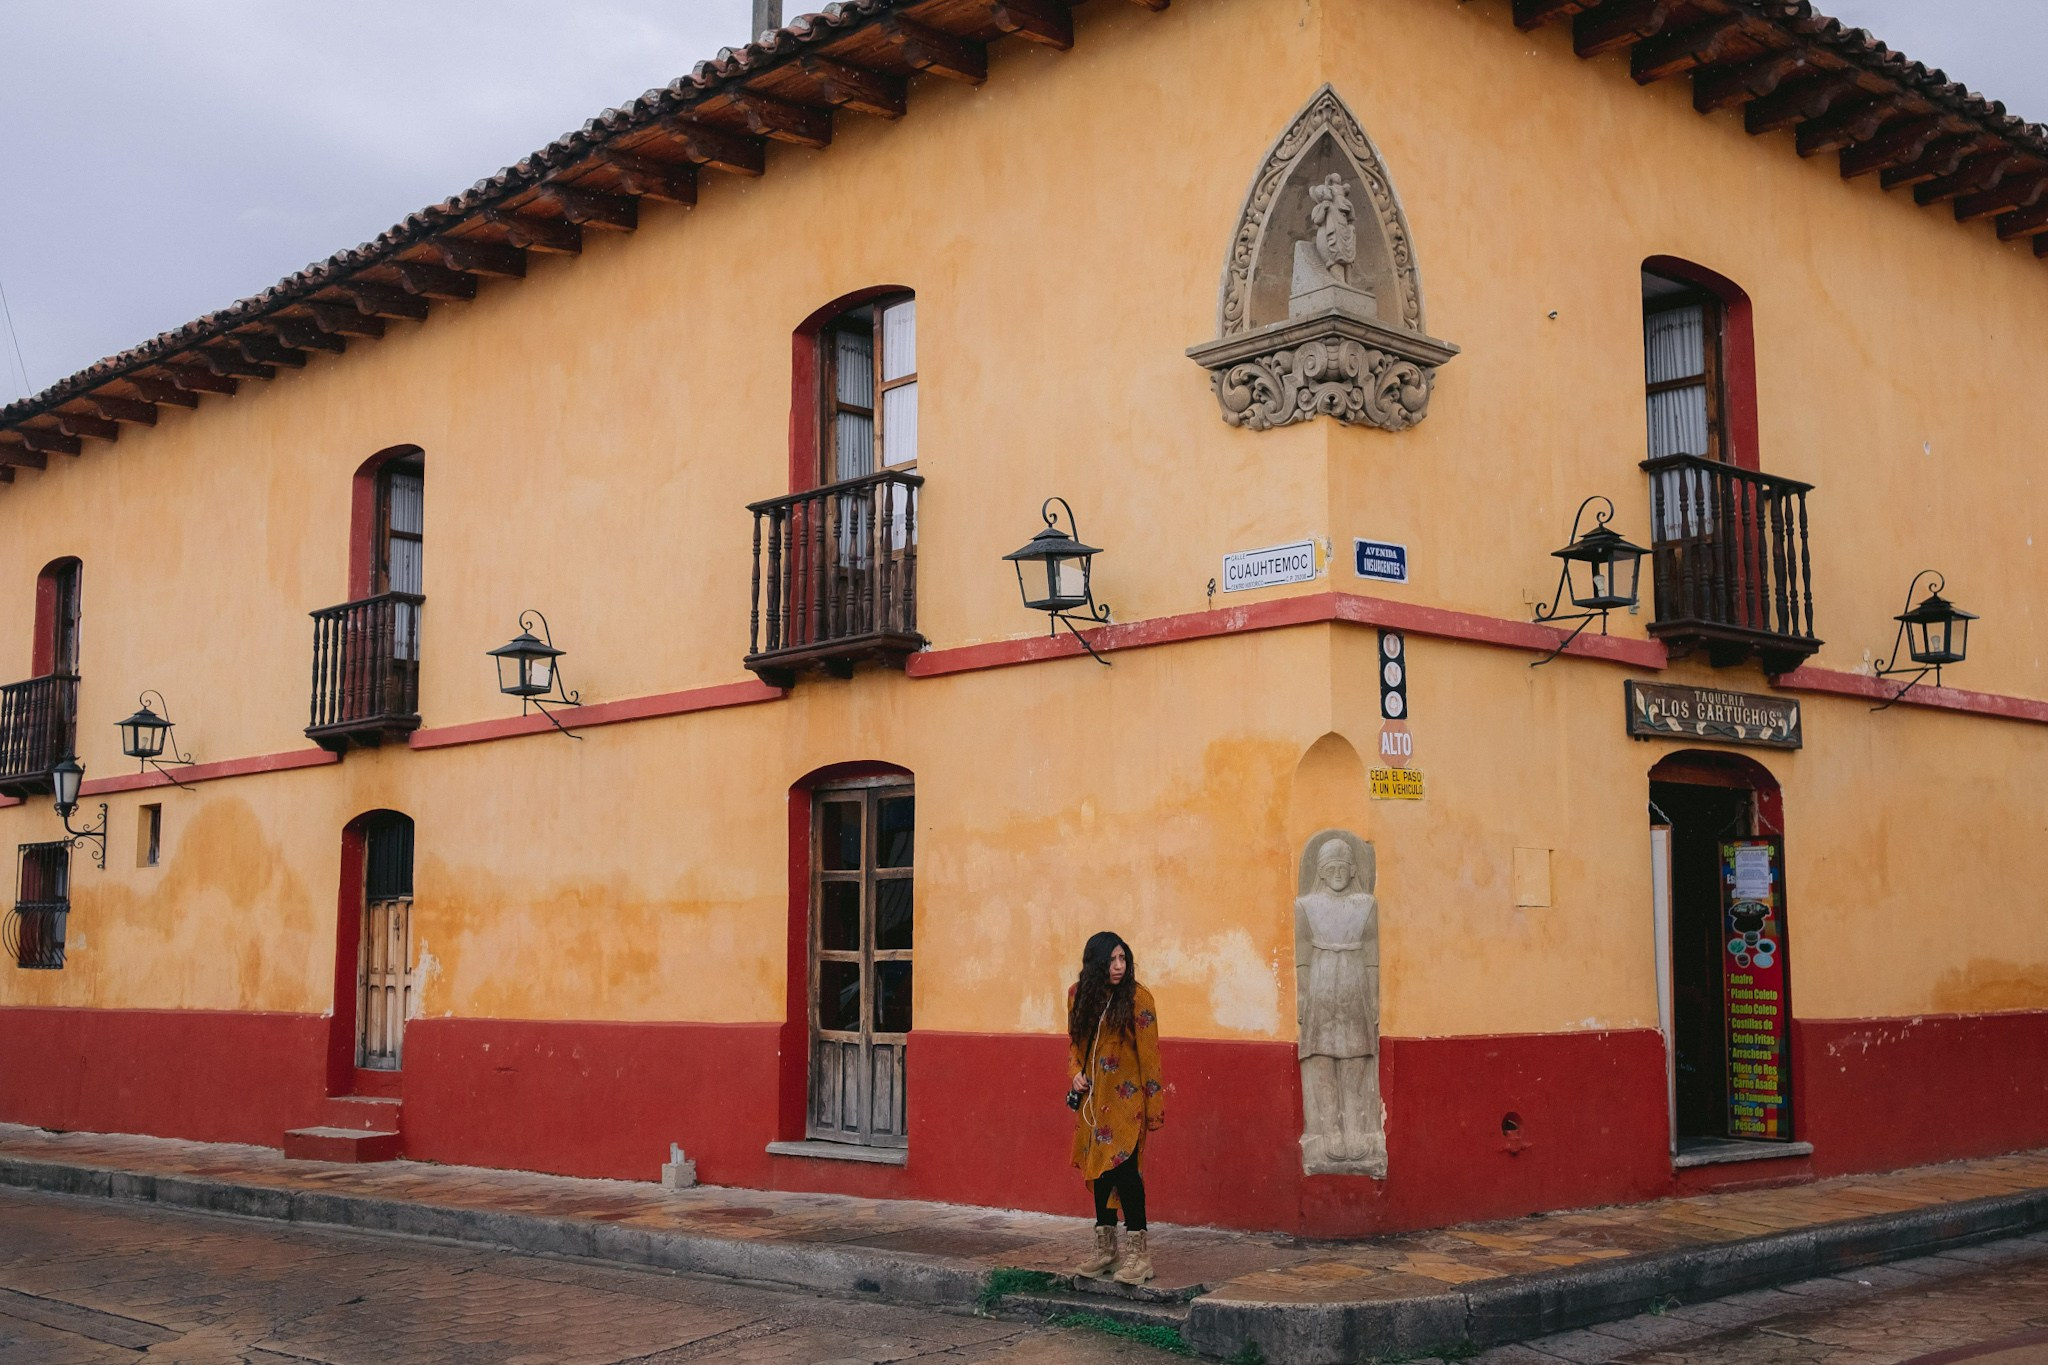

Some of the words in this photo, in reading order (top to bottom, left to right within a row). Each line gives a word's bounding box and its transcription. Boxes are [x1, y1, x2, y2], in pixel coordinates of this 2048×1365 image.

[1230, 553, 1246, 562] CALLE
[1365, 546, 1398, 559] AVENIDA
[1229, 554, 1308, 580] CUAUHTEMOC
[1363, 558, 1400, 576] INSURGENTES
[1694, 690, 1745, 707] TAQUERIA
[1655, 698, 1690, 719] "LOS
[1381, 731, 1412, 756] ALTO
[1370, 769, 1389, 781] CEDA
[1392, 770, 1401, 782] EL
[1403, 771, 1422, 783] PASO
[1372, 782, 1377, 794] A
[1380, 782, 1389, 794] UN
[1392, 783, 1423, 795] VEHICULO
[1730, 973, 1754, 985] Anafre
[1754, 988, 1778, 1001] Coleto
[1731, 1003, 1753, 1015] Asado
[1753, 1003, 1778, 1016] Coleto
[1731, 1017, 1763, 1030] Costillas
[1763, 1019, 1773, 1030] de
[1732, 1032, 1754, 1044] Cerdo
[1754, 1033, 1775, 1046] Fritas
[1732, 1047, 1772, 1060] Arracheras
[1733, 1062, 1753, 1074] Filete
[1753, 1063, 1763, 1075] de
[1763, 1064, 1778, 1076] Res
[1733, 1077, 1754, 1089] Carne
[1755, 1078, 1778, 1091] Asada
[1738, 1092, 1745, 1101] la
[1734, 1104, 1753, 1116] Filete
[1754, 1106, 1764, 1117] de
[1735, 1119, 1766, 1133] Pescado
